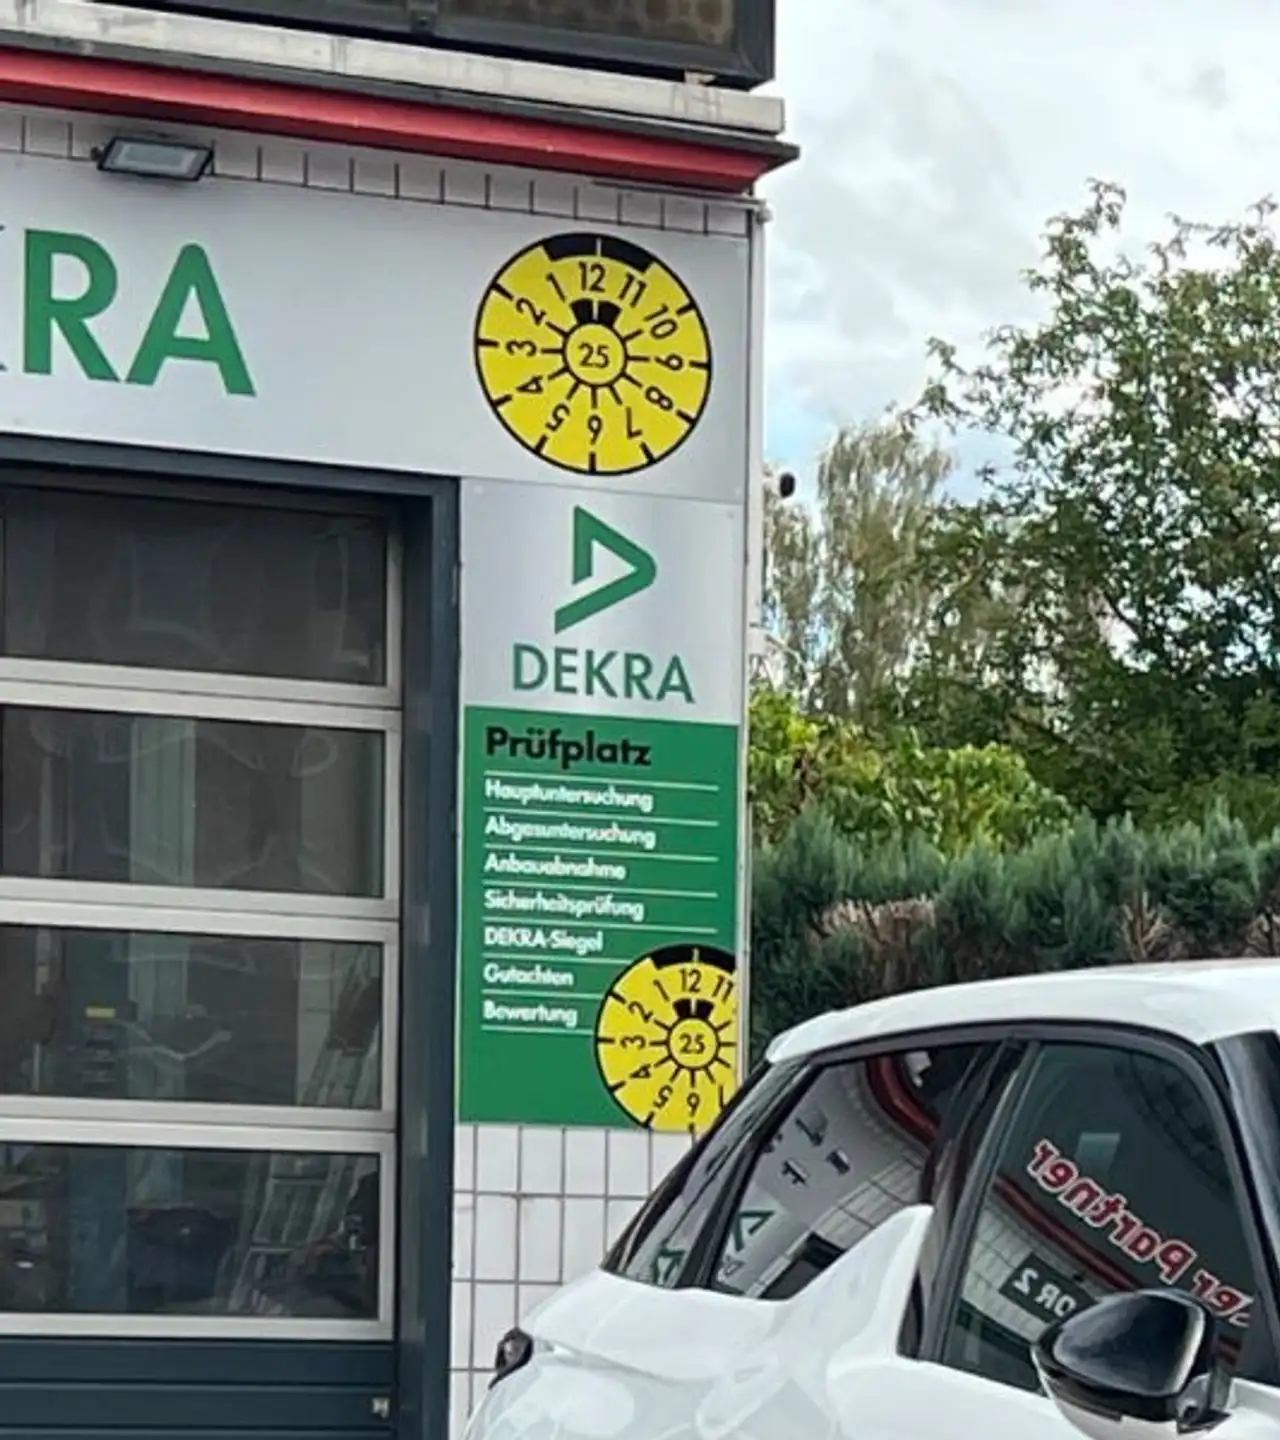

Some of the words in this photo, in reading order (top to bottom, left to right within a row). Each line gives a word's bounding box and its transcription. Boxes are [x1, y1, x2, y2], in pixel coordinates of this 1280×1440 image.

[545, 272, 566, 302] 1
[578, 261, 606, 293] 12
[618, 273, 648, 308] 11
[0, 224, 257, 397] RA
[515, 297, 547, 326] 2
[644, 303, 678, 339] 10
[505, 339, 537, 357] 3
[577, 342, 610, 369] 25
[654, 354, 684, 371] 9
[515, 375, 544, 394] 4
[644, 386, 674, 412] 8
[545, 403, 571, 432] 5
[587, 414, 603, 446] 6
[624, 406, 643, 440] 7
[512, 642, 696, 704] DEKRA
[486, 726, 652, 770] Prüfplatz
[484, 778, 654, 813] Hauptuntersuchung
[484, 815, 656, 850] Abgasuntersuchung
[484, 852, 627, 880] Anbauabnahme
[483, 889, 645, 922] Sicherheitsprüfung
[483, 926, 604, 956] DEKRA-Siegel
[483, 963, 575, 986] Gutachten
[678, 968, 702, 994] 12
[653, 979, 670, 1003] 1
[483, 999, 578, 1029] Bewertung
[627, 1000, 653, 1024] 2
[620, 1034, 646, 1050] 3
[678, 1032, 706, 1055] 25
[629, 1063, 652, 1079] 4
[652, 1084, 673, 1109] 5
[686, 1092, 700, 1117] 6
